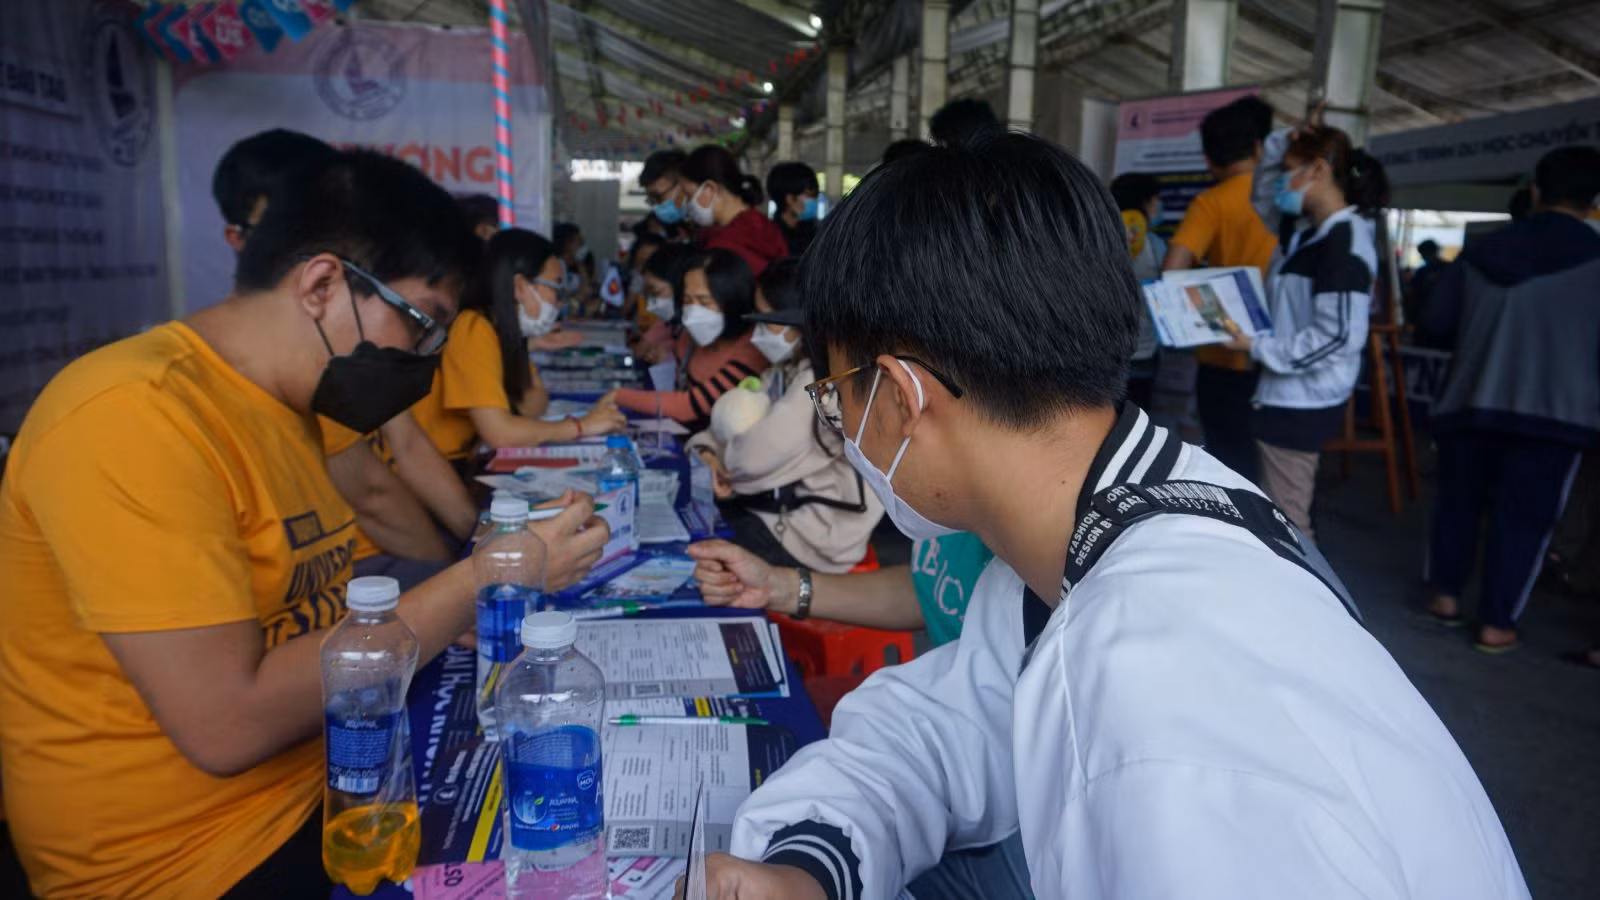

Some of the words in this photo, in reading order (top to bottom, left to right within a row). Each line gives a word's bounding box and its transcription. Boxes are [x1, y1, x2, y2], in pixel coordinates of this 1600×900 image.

[1069, 510, 1101, 555] FASHION
[1106, 485, 1131, 503] ORT
[1075, 526, 1104, 567] DESIGN
[1100, 518, 1112, 529] B
